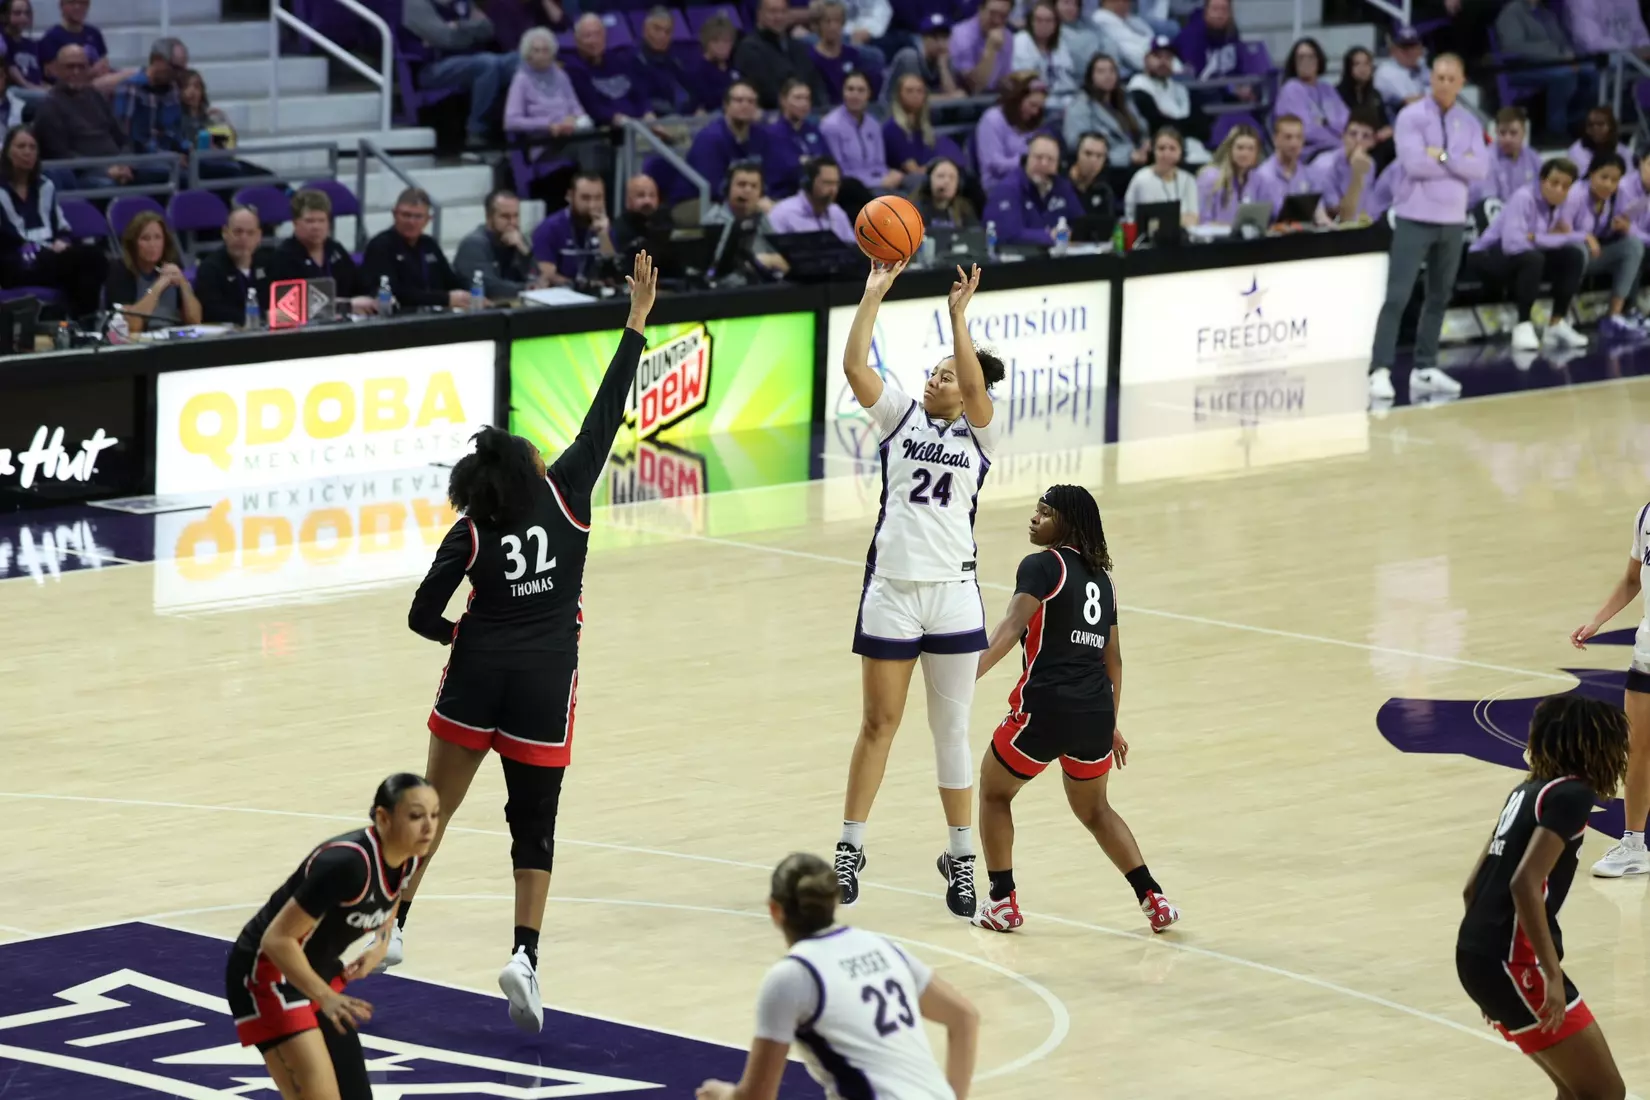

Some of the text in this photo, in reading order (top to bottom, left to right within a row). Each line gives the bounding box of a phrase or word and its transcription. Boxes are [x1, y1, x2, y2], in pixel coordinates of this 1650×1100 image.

[923, 298, 1087, 349] Acension
[1197, 318, 1307, 353] FREEDOM
[988, 350, 1093, 400] hristi
[178, 369, 467, 472] QDOBA
[17, 424, 119, 489] Hut
[243, 433, 461, 470] MEXICAN EATS
[902, 439, 970, 469] Wildcats
[909, 468, 954, 508] 24
[501, 525, 556, 580] 32
[510, 576, 554, 597] THOMAS
[1083, 581, 1102, 625] 8
[1070, 629, 1105, 649] CRAWFORD
[861, 978, 915, 1037] 23
